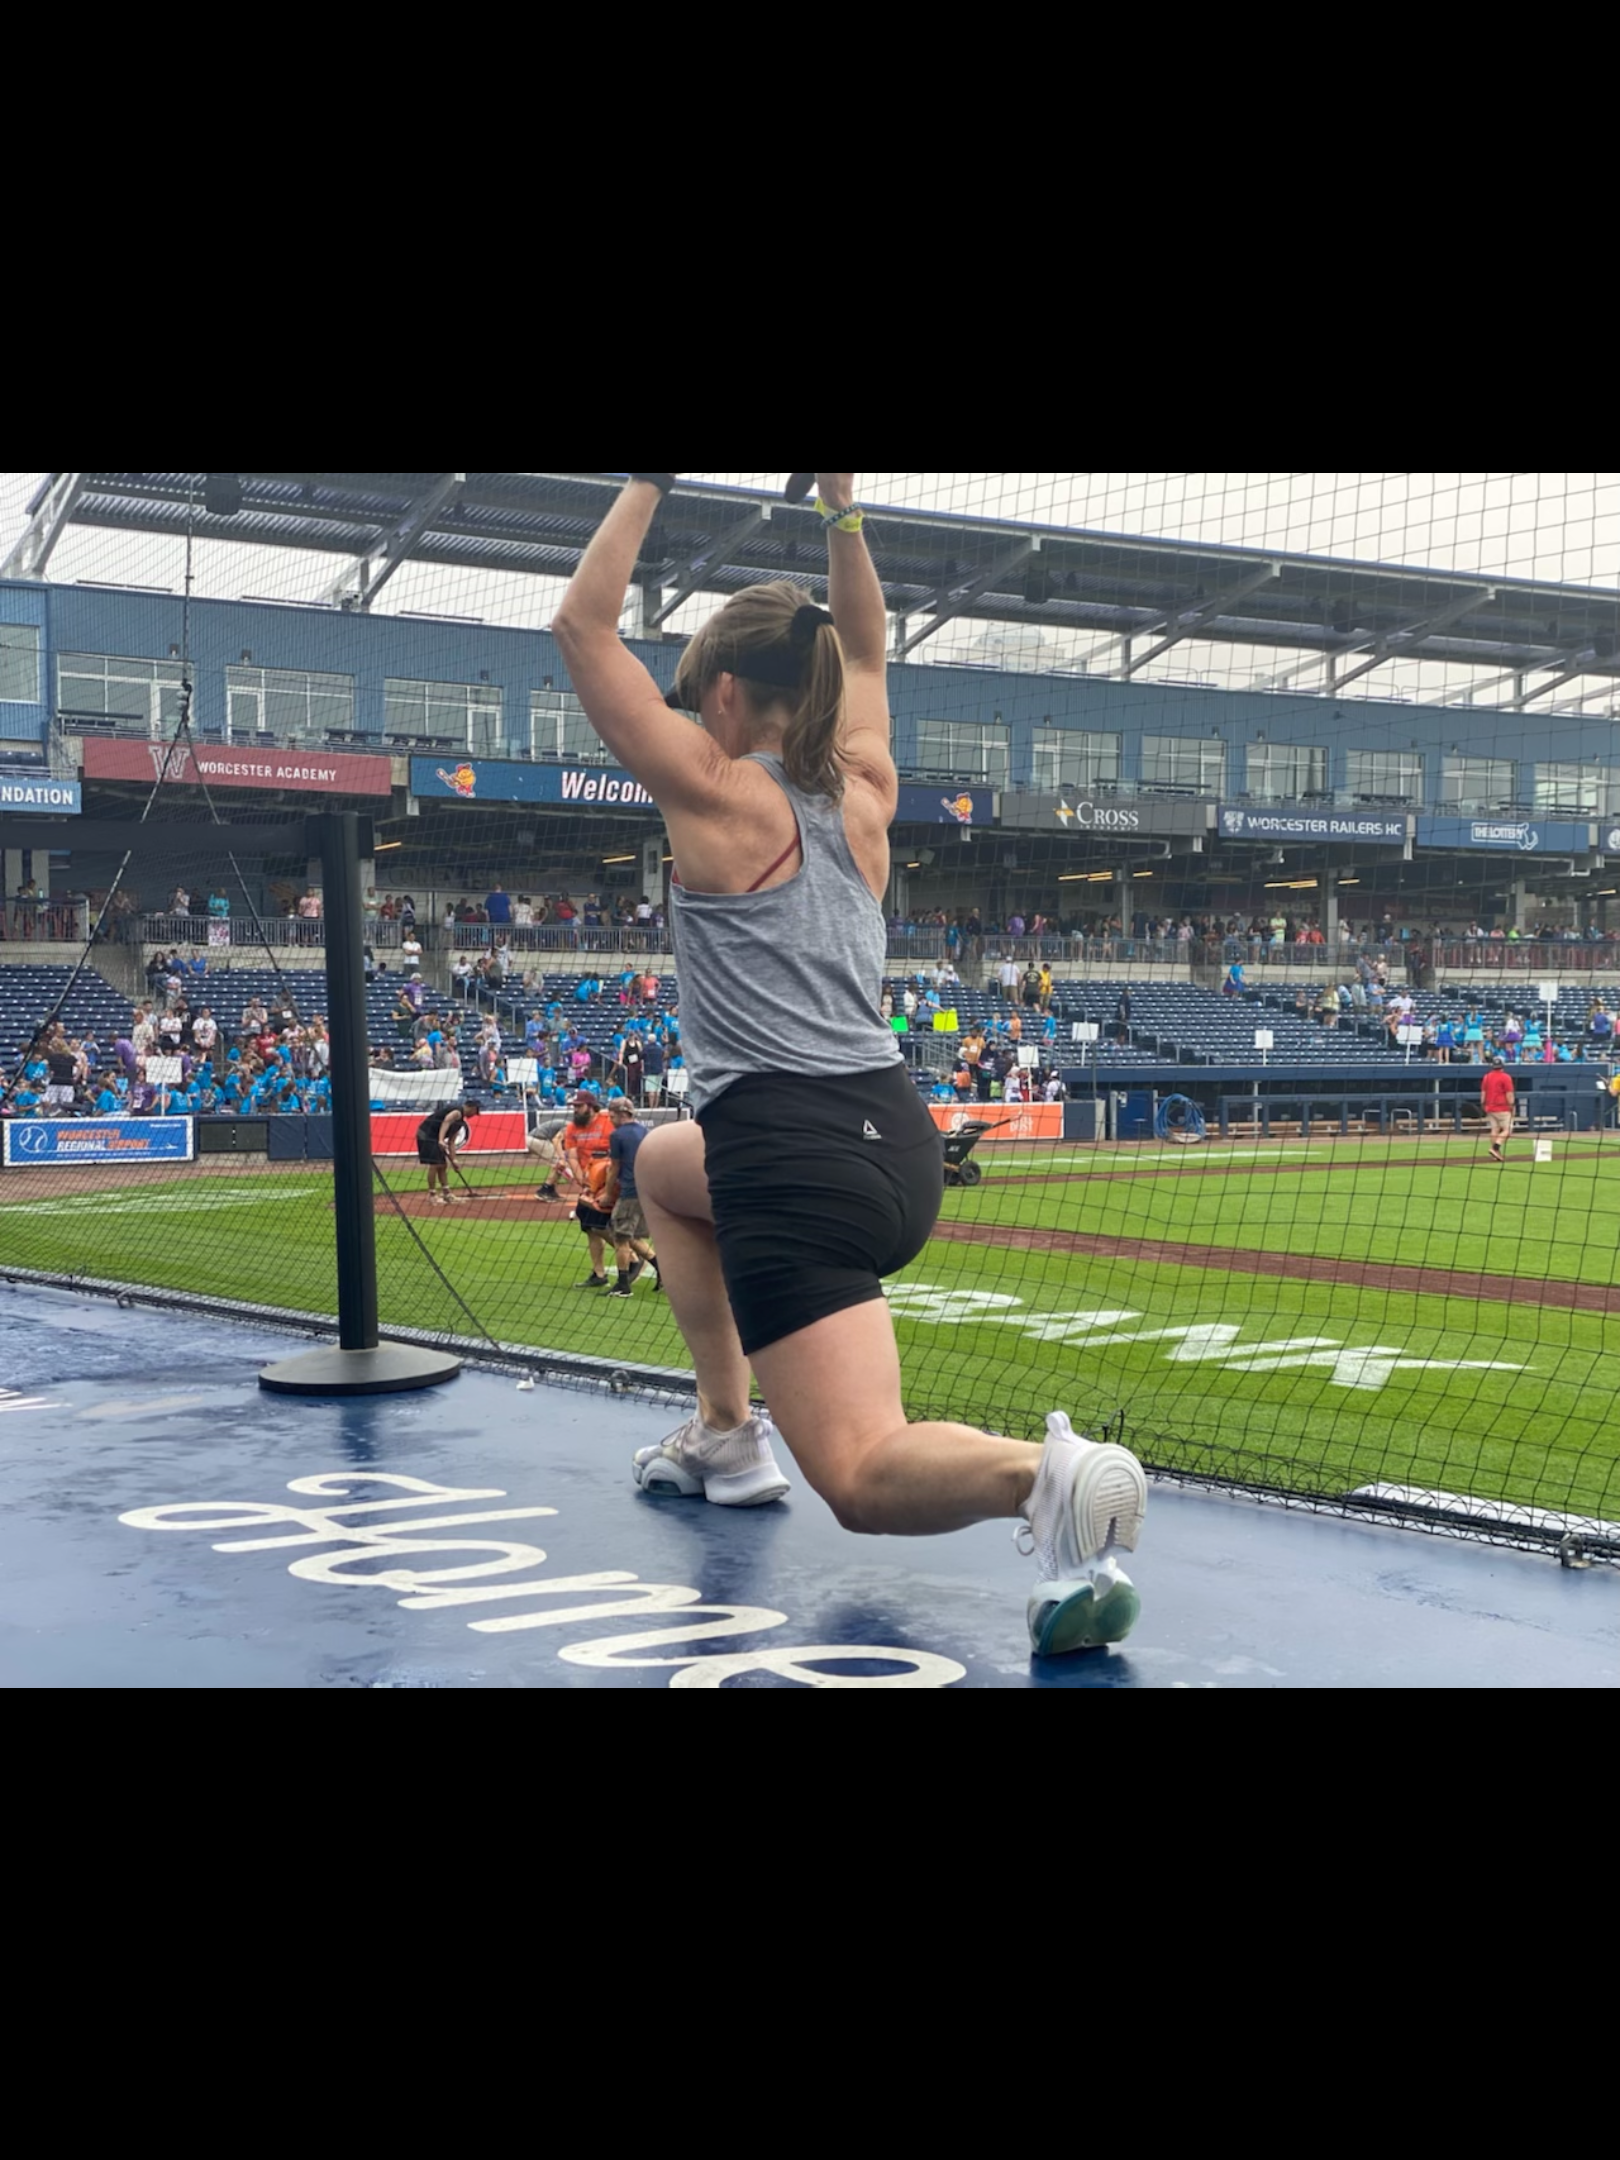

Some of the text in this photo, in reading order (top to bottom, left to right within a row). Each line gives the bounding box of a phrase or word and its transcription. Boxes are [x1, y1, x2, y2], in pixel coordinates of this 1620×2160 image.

[197, 761, 337, 781] WORCESTER ACADEMY
[1, 785, 73, 806] NDATION
[1247, 816, 1402, 836] WORCESTER RAILERS HC
[57, 1129, 121, 1140] WORCESTER
[56, 1140, 107, 1151] REGIONAL
